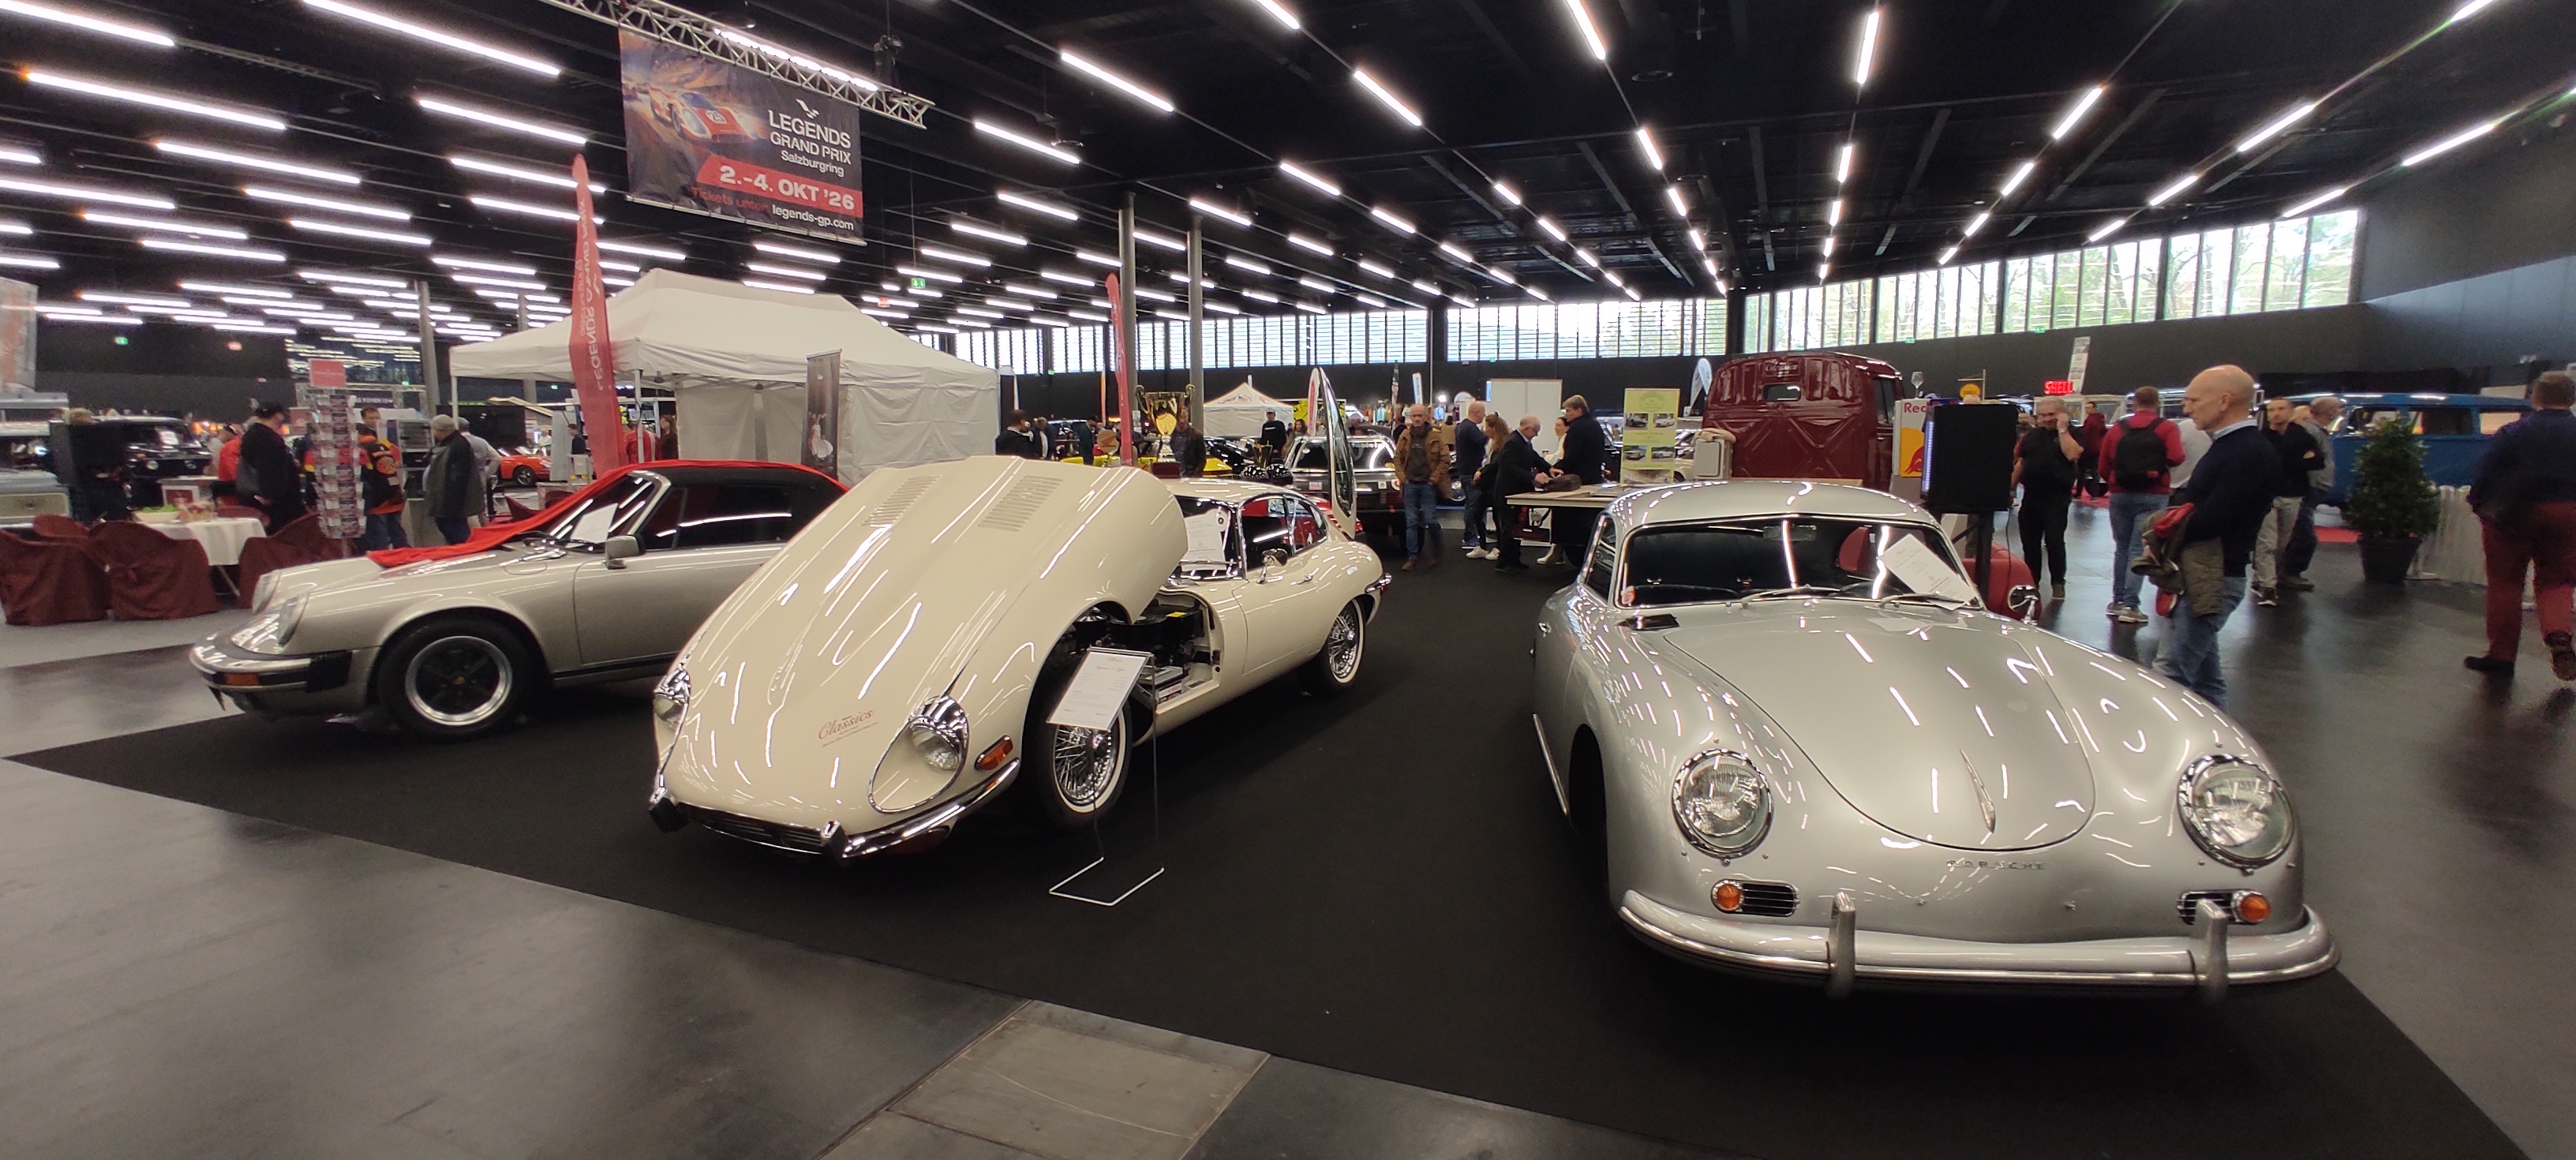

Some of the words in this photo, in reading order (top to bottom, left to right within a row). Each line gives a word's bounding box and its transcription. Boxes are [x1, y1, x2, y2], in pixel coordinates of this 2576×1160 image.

[768, 110, 852, 149] LEGENDS
[770, 131, 820, 155] GRAND
[821, 144, 852, 165] PRIX
[781, 150, 844, 178] Salzburgring
[720, 165, 773, 193] 2.-4.
[778, 178, 820, 202] OKT
[691, 186, 734, 206] Tickets
[771, 204, 855, 231] legends-gp.com
[2044, 380, 2074, 395] SHELL
[818, 709, 874, 740] Classics
[1946, 859, 2046, 870] PORSCHE
